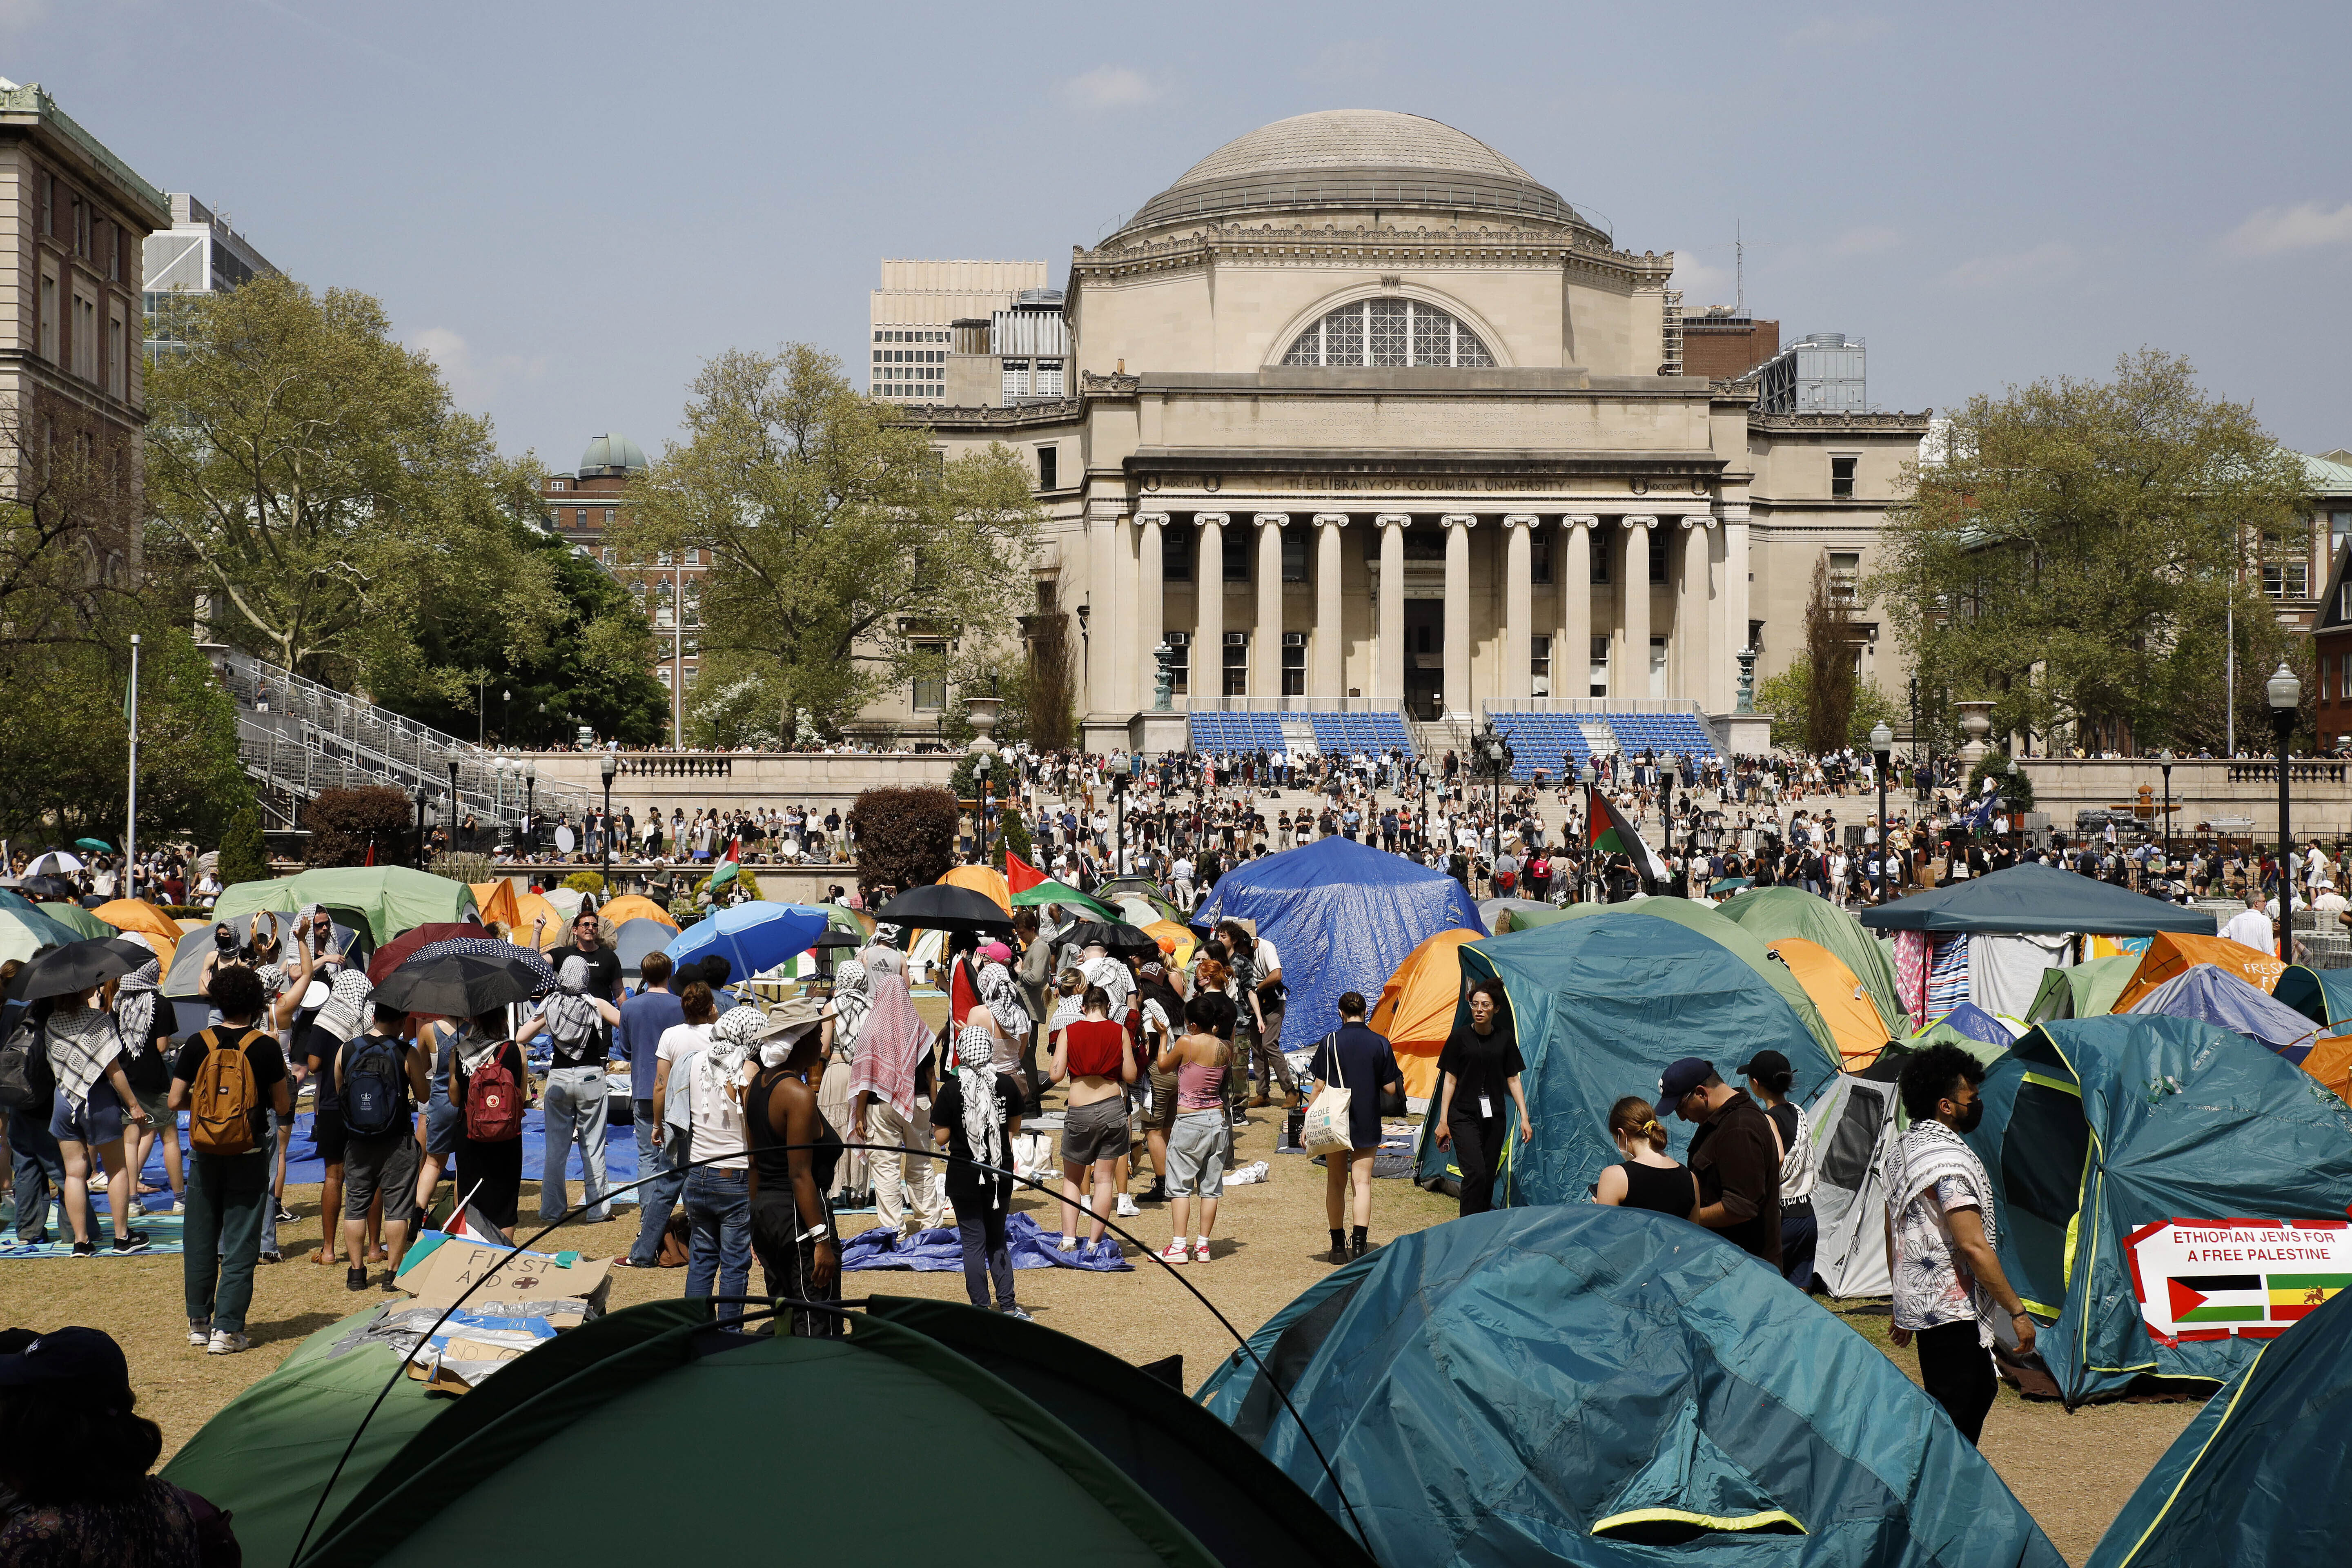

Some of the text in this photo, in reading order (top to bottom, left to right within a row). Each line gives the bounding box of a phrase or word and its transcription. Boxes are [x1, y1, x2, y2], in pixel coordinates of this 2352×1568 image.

[1287, 479, 1566, 491] THE LIBRARY OF COLUMBIA UNIVERSITY
[2243, 962, 2287, 975] FRESH
[1307, 1127, 1332, 1138] SCIENCES
[1309, 1136, 1334, 1146] SOCIALES
[2173, 1231, 2336, 1244] ETHIOPIAN JEWS FOR
[468, 1249, 556, 1274] FIRST
[2187, 1248, 2331, 1262] A FREE PALESTINE
[455, 1270, 502, 1288] AID
[450, 1343, 479, 1361] NO
